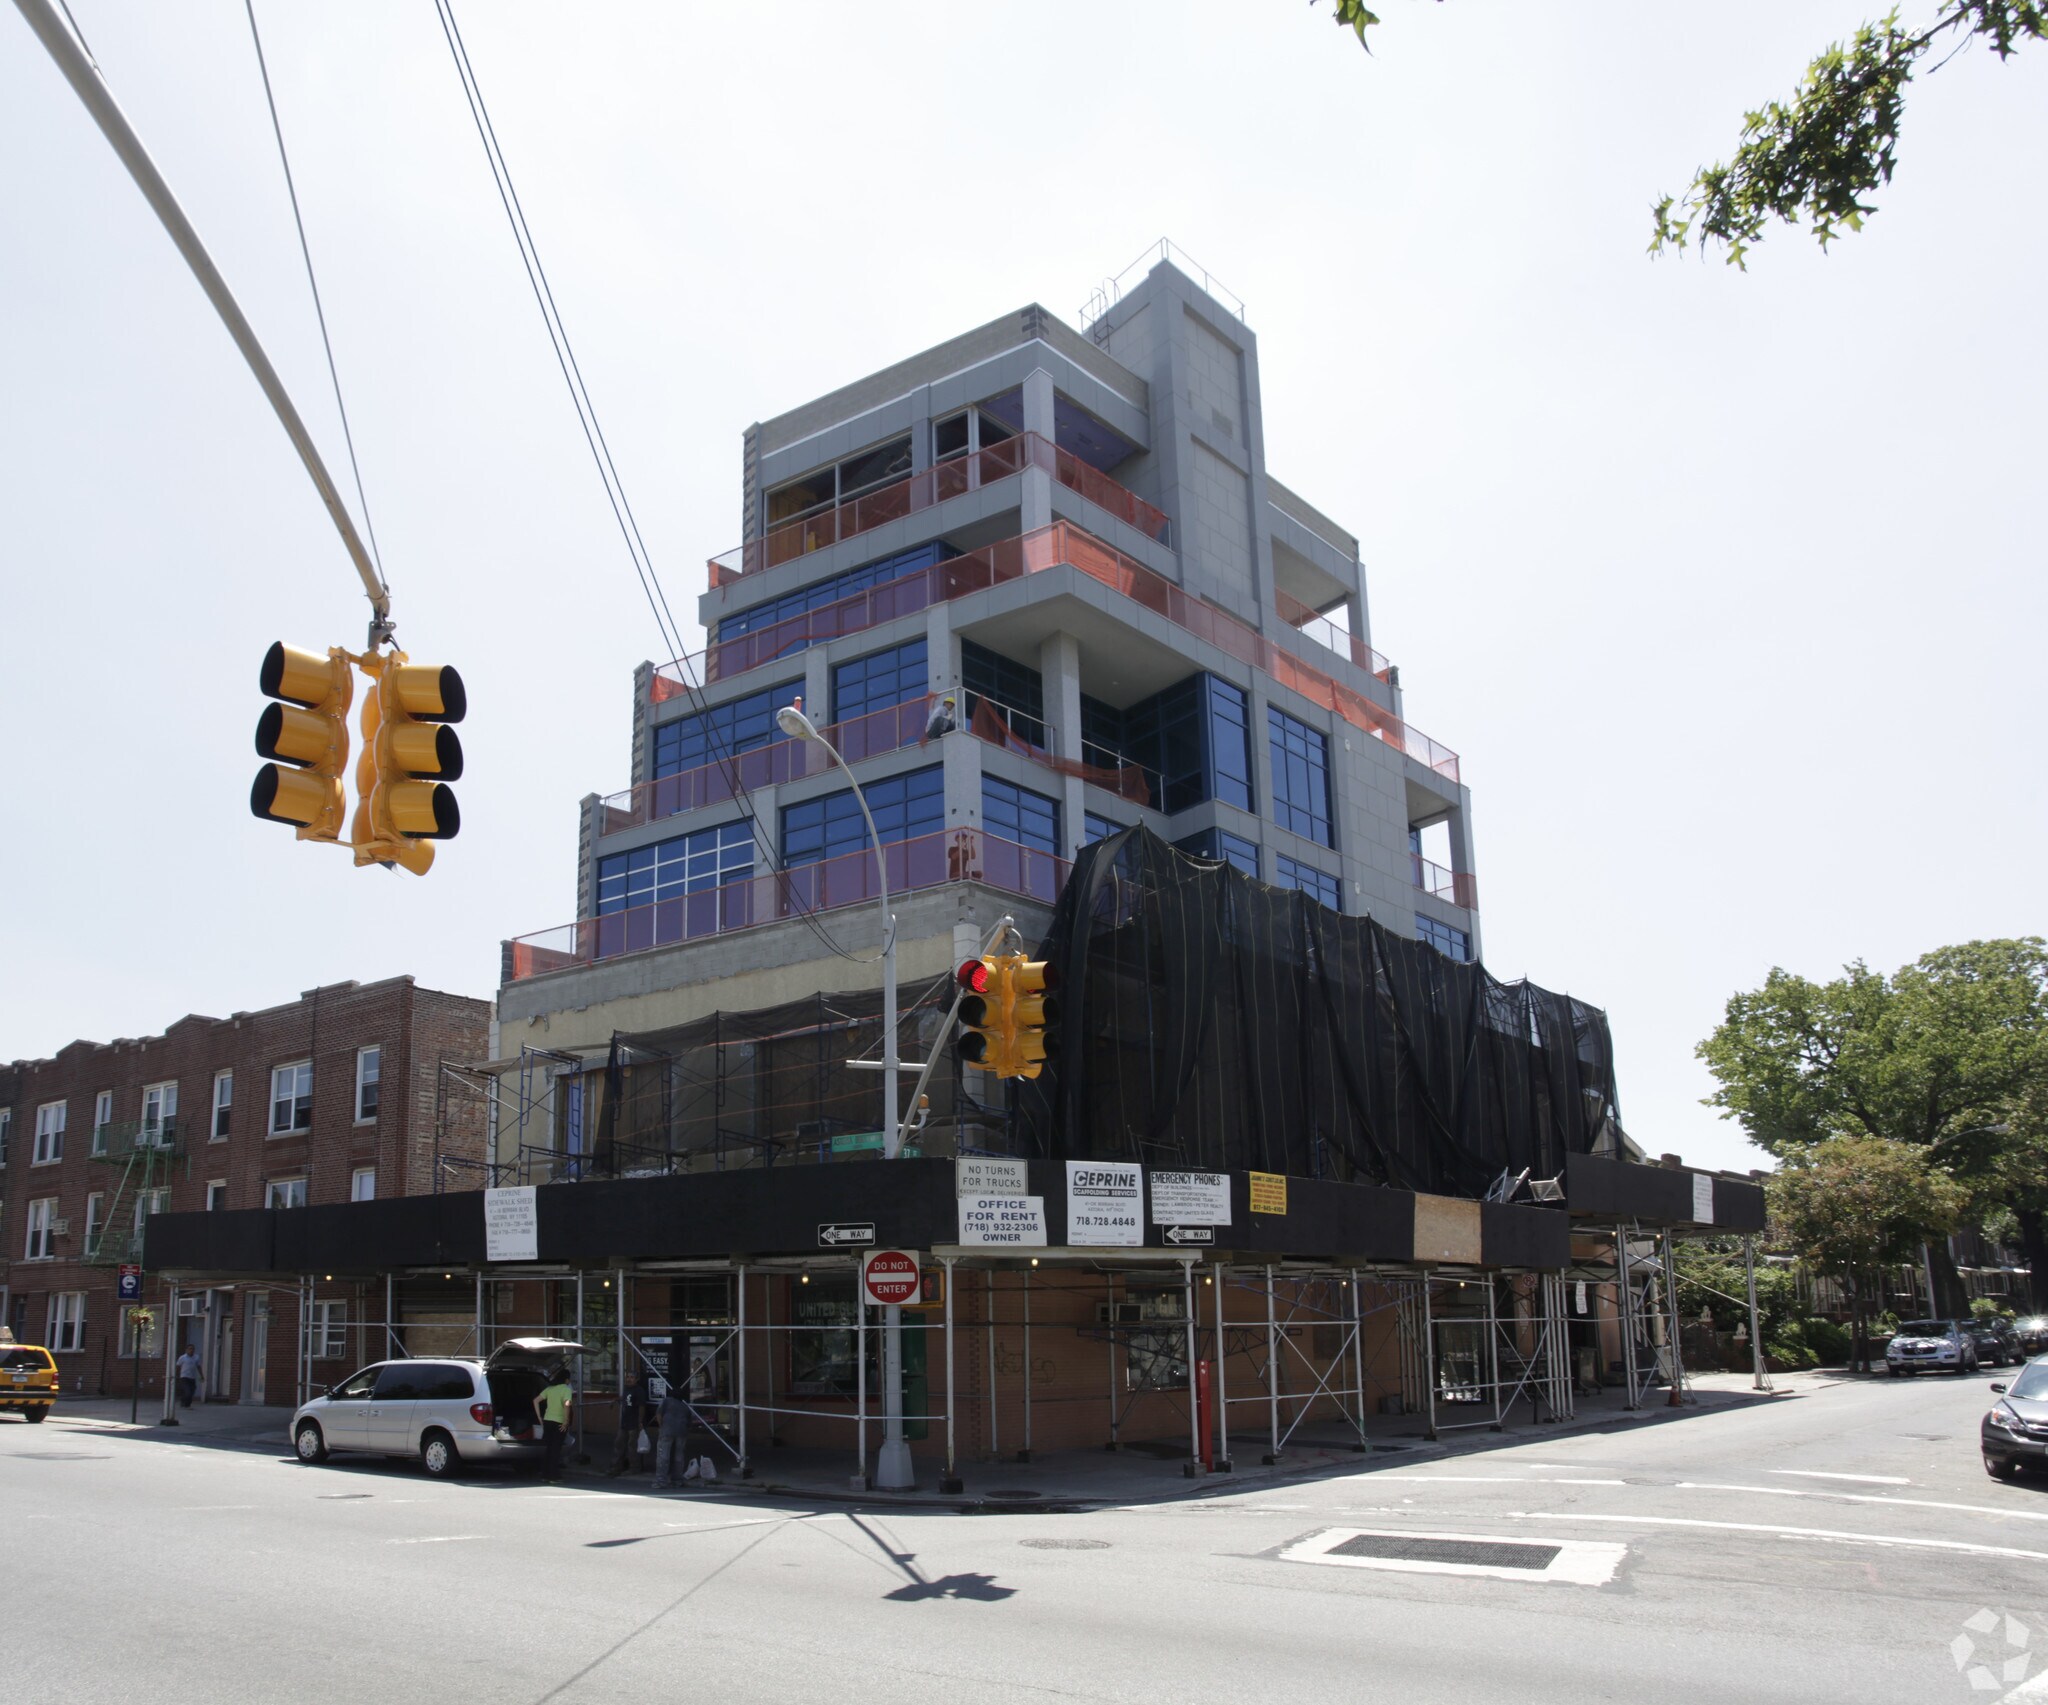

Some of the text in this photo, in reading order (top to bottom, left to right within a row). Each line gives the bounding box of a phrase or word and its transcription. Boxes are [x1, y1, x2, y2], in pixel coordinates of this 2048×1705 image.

[903, 1148, 911, 1158] 37
[968, 1166, 1016, 1176] NO TURNS
[962, 1177, 1022, 1188] FOR TRUCKS
[1074, 1171, 1136, 1187] CEPRINE
[1151, 1173, 1223, 1186] EMERGENCY PHONES:
[1111, 1189, 1137, 1197] SERVICES
[978, 1200, 1026, 1209] OFFICE
[967, 1212, 1037, 1220] FOR RENT
[1076, 1217, 1136, 1226] 718.728.4848
[964, 1223, 1038, 1232] (718) 932-2306
[826, 1230, 866, 1239] ONE WAY
[983, 1234, 1021, 1242] OWNER
[1173, 1231, 1208, 1239] ONE WAY
[874, 1262, 908, 1270] DO NOT
[877, 1285, 907, 1294] ENTER
[800, 1302, 872, 1317] UNITED GLAS
